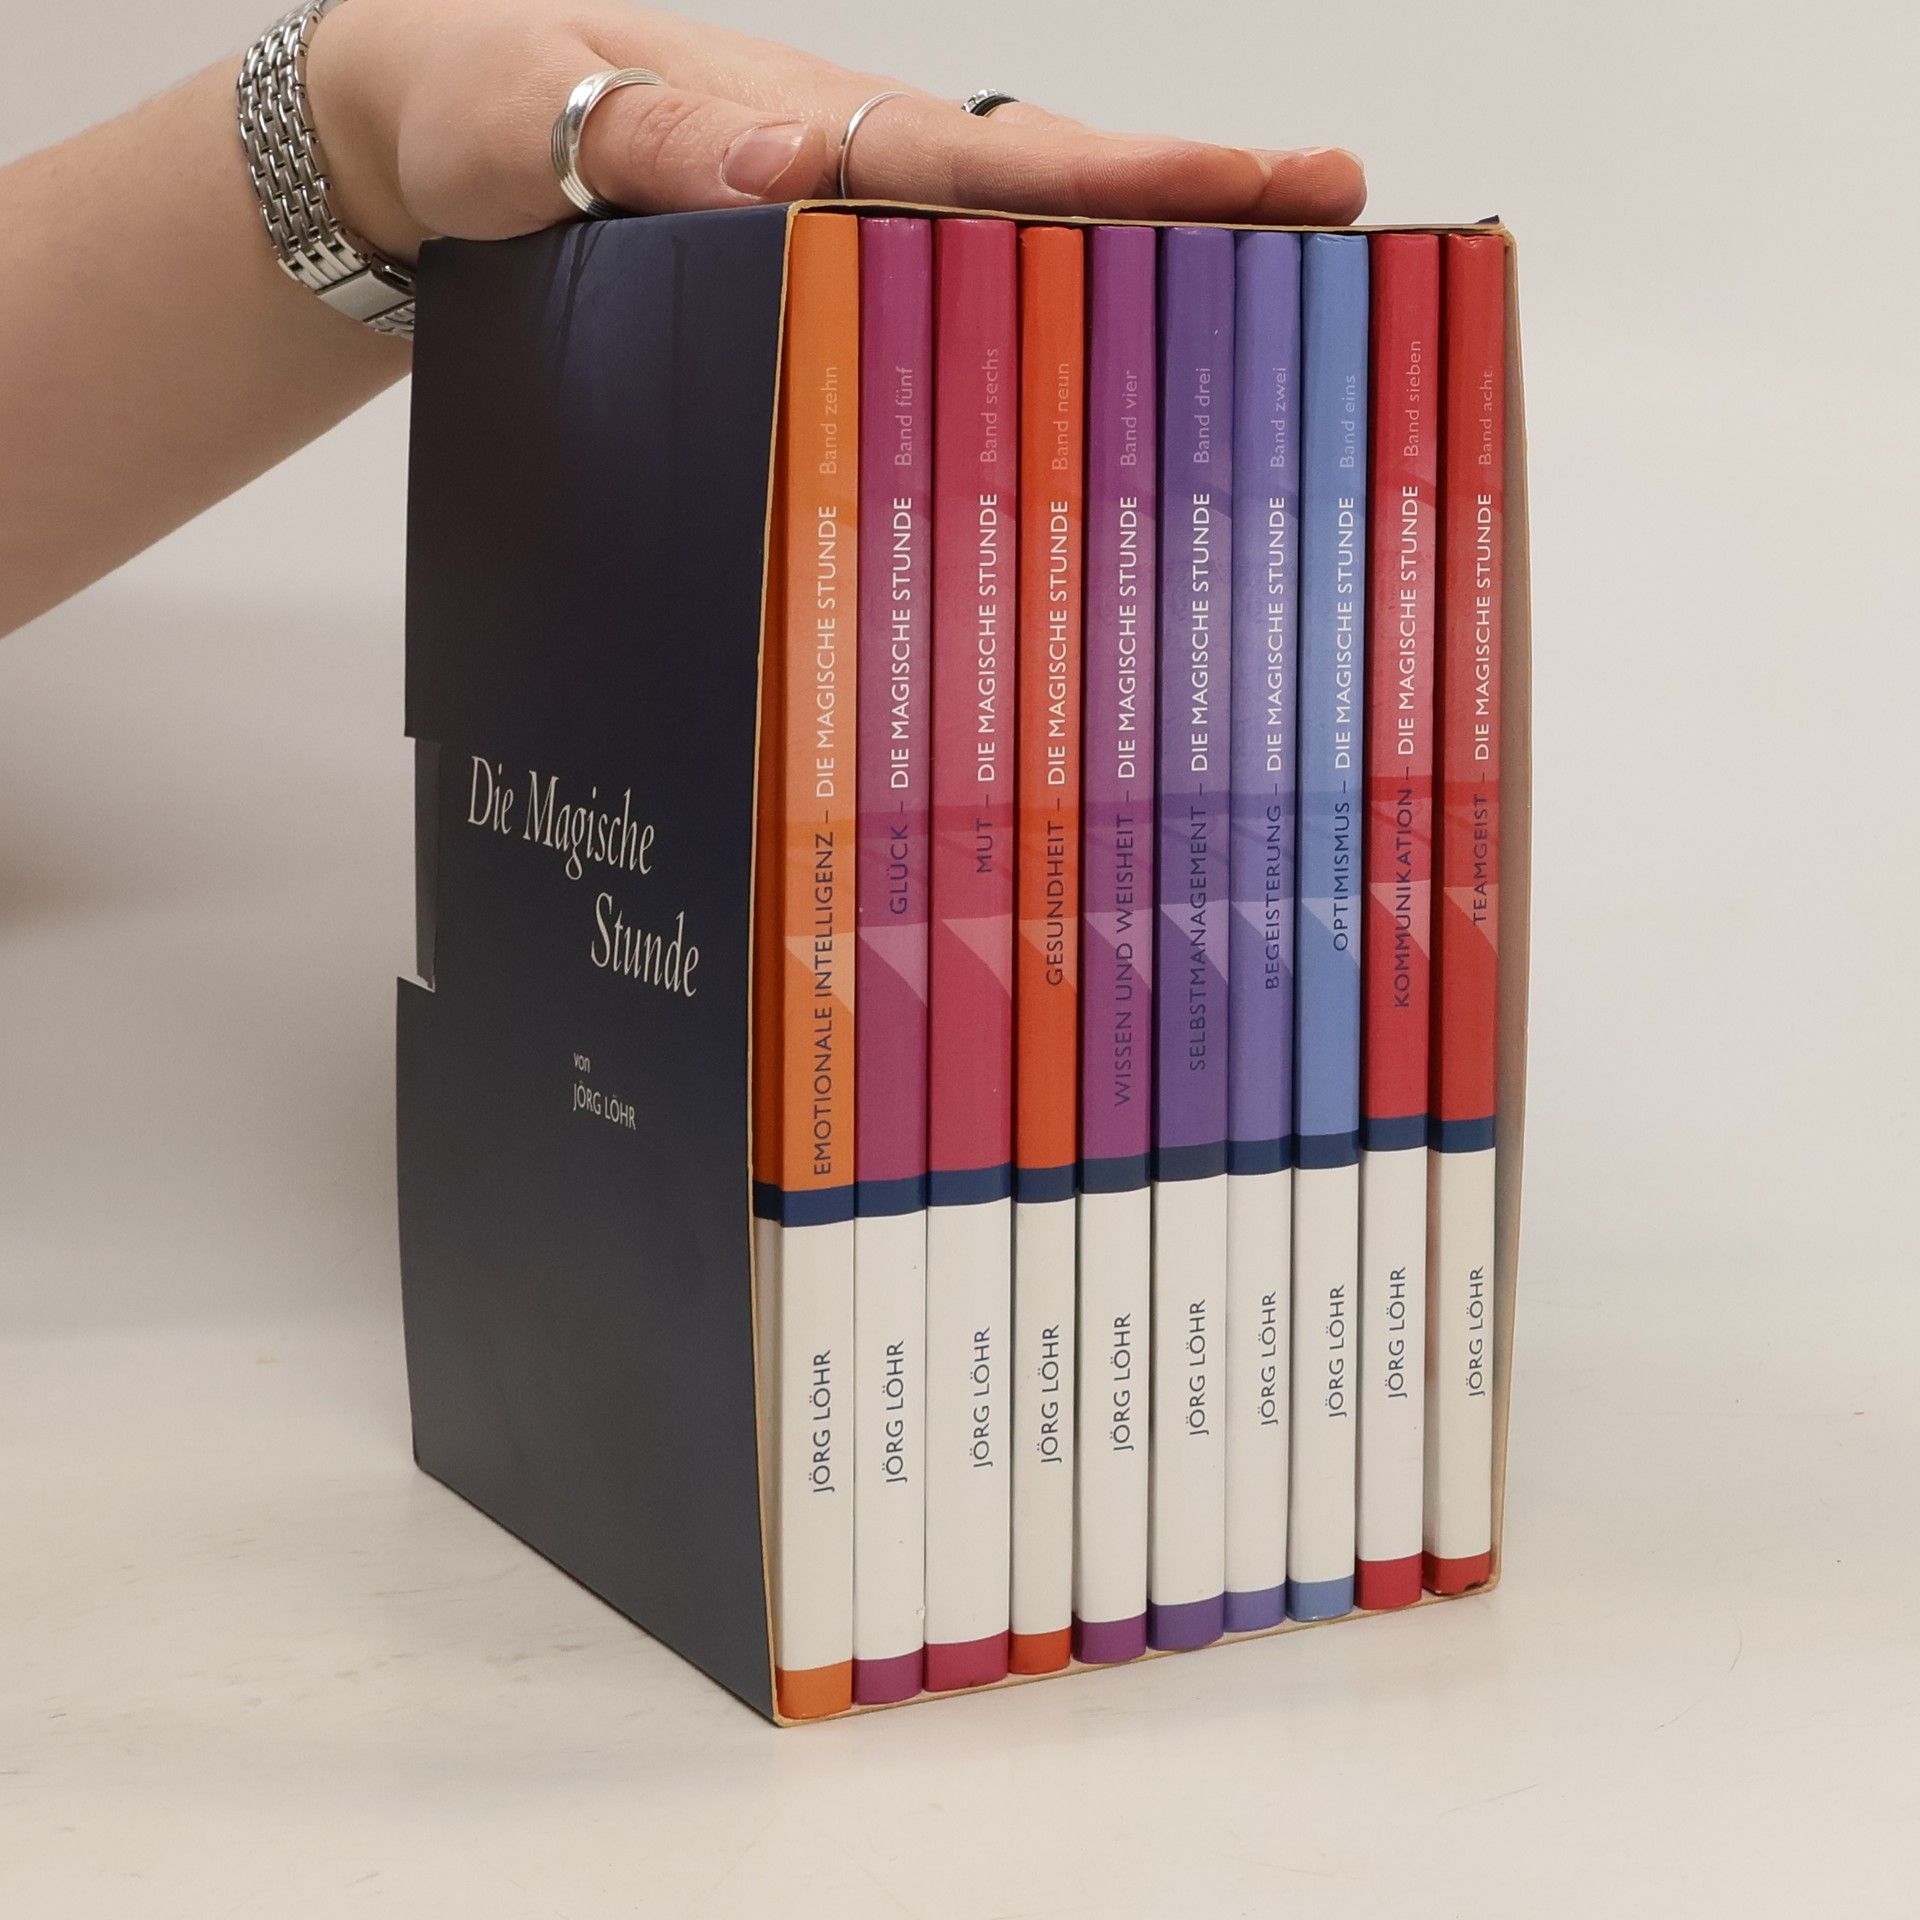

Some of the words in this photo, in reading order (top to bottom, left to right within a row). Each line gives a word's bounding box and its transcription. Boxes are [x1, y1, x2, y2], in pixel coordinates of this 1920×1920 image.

[819, 366, 838, 414] zehn
[894, 366, 912, 407] fünf
[980, 348, 999, 404] sechs
[1057, 362, 1070, 412] neun
[1121, 370, 1138, 408] vier
[1194, 368, 1211, 406] drei
[1270, 367, 1286, 412] zwei
[1340, 375, 1356, 412] eins
[1404, 340, 1421, 401] sieben
[1479, 370, 1493, 412] acht
[819, 421, 838, 474] Band
[894, 414, 912, 466] Band
[980, 411, 999, 462] Band
[1052, 418, 1070, 470] Band
[1121, 414, 1138, 466] Band
[1194, 413, 1211, 463] Band
[1270, 418, 1286, 467] Band
[1340, 418, 1356, 468] Band
[1404, 408, 1421, 456] Band
[1479, 418, 1493, 465] Band
[816, 506, 836, 609] STUNDE
[891, 497, 911, 601] STUNDE
[978, 494, 997, 596] STUNDE
[1049, 501, 1068, 602] STUNDE
[1118, 496, 1137, 596] STUNDE
[1191, 493, 1210, 592] STUNDE
[1266, 497, 1284, 592] STUNDE
[1336, 497, 1354, 592] STUNDE
[1398, 486, 1418, 581] STUNDE
[1474, 494, 1492, 588] STUNDE
[891, 609, 911, 739] MAGISCHE
[978, 604, 997, 733] MAGISCHE
[1049, 610, 1068, 737] MAGISCHE
[1118, 604, 1137, 731] MAGISCHE
[1191, 600, 1210, 724] MAGISCHE
[1266, 601, 1284, 724] MAGISCHE
[1336, 600, 1354, 722] MAGISCHE
[1398, 588, 1418, 709] MAGISCHE
[1474, 596, 1492, 716] MAGISCHE
[816, 618, 836, 749] MAGISCHE
[891, 748, 911, 789] DIE
[978, 742, 997, 781] DIE
[1049, 746, 1068, 785] DIE
[1118, 739, 1137, 778] DIE
[1191, 732, 1210, 771] DIE
[1266, 732, 1284, 771] DIE
[1336, 731, 1354, 769] DIE
[1398, 718, 1418, 755] DIE
[1474, 724, 1492, 761] DIE
[816, 758, 836, 798] DIE
[468, 756, 514, 834] Die
[523, 769, 655, 880] Magische
[976, 818, 994, 873] MUT
[887, 824, 909, 914] GLÜCK
[1113, 813, 1135, 934] WEISHEIT
[1332, 802, 1350, 951] OPTIMISMUS
[1471, 794, 1490, 925] TEAMGEIST
[813, 831, 833, 997] INTELLIGENZ
[1046, 821, 1065, 986] GESUNDHEIT
[1264, 805, 1282, 989] BEGEISTERUNG
[1392, 788, 1413, 1008] KOMMUNIKATION
[591, 892, 699, 997] Stunde
[1189, 805, 1208, 1071] SELBSTMANAGEMENT
[1113, 943, 1135, 1001] UND
[573, 1052, 591, 1074] von
[1113, 1011, 1135, 1106] WISSEN
[573, 1080, 602, 1114] JÖRG
[605, 1093, 636, 1131] LÖHR
[813, 1007, 833, 1175] EMOTIONALE
[1257, 1291, 1277, 1357] LÖHR
[1325, 1284, 1345, 1350] LÖHR
[1385, 1267, 1405, 1331] LÖHR
[1465, 1266, 1484, 1330] LÖHR
[969, 1326, 990, 1396] LÖHR
[1038, 1324, 1059, 1392] LÖHR
[1110, 1312, 1130, 1381] LÖHR
[1185, 1299, 1207, 1366] LÖHR
[809, 1349, 832, 1421] LÖHR
[882, 1340, 906, 1412] LÖHR
[1257, 1365, 1279, 1426] JÖRG
[1325, 1358, 1347, 1418] JÖRG
[1385, 1339, 1407, 1399] JÖRG
[1465, 1338, 1486, 1397] JÖRG
[969, 1405, 992, 1468] JÖRG
[1038, 1401, 1061, 1464] JÖRG
[1110, 1389, 1132, 1451] JÖRG
[1185, 1374, 1209, 1436] JÖRG
[809, 1428, 834, 1493] JÖRG
[882, 1419, 908, 1484] JÖRG
